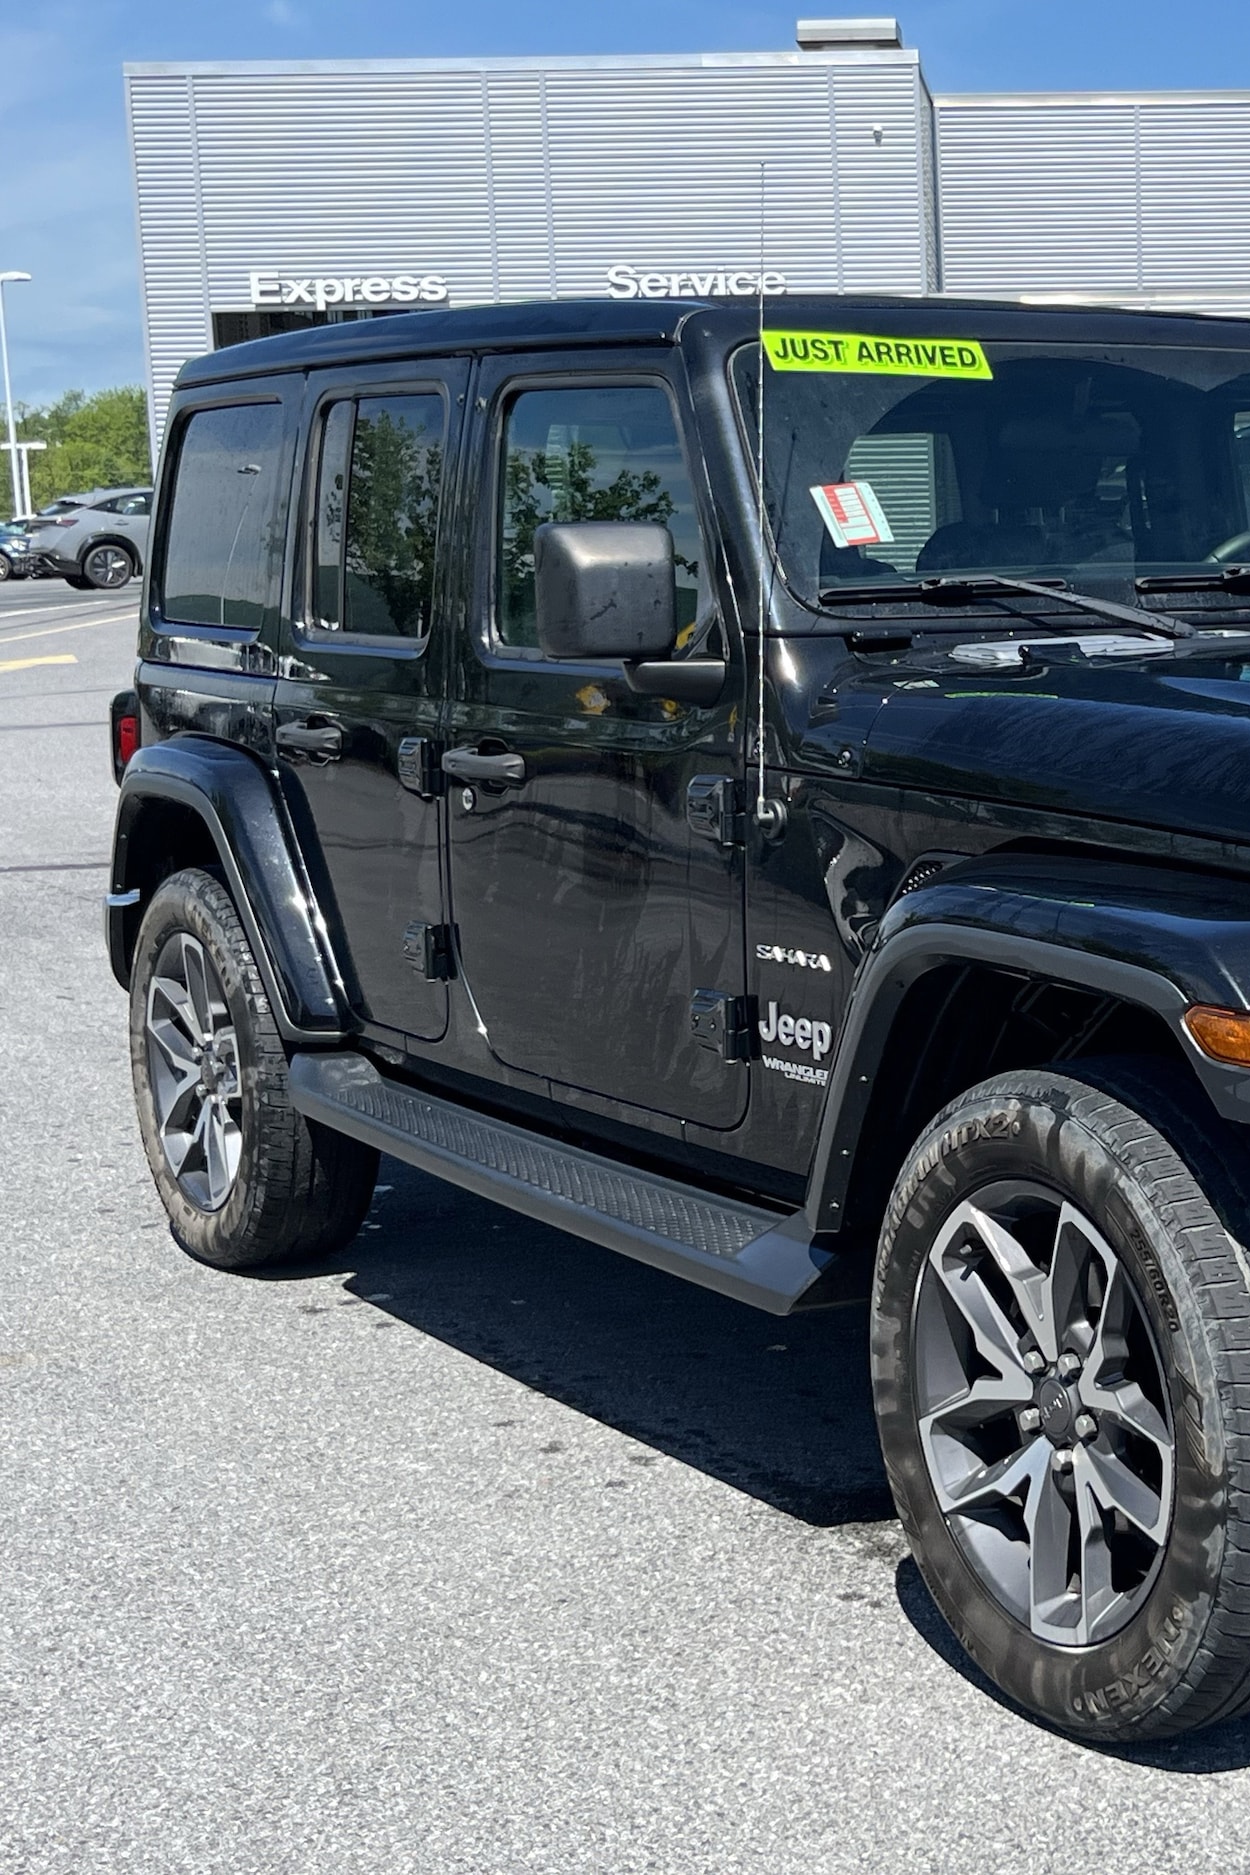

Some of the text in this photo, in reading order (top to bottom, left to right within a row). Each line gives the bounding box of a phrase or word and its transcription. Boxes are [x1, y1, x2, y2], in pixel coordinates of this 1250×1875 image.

[249, 271, 450, 311] Express
[607, 264, 788, 299] Service
[774, 337, 980, 370] JUST ARRIVED
[756, 944, 832, 972] SAHARA
[758, 1001, 833, 1062] Jeep
[1083, 1616, 1181, 1715] NEXEN
